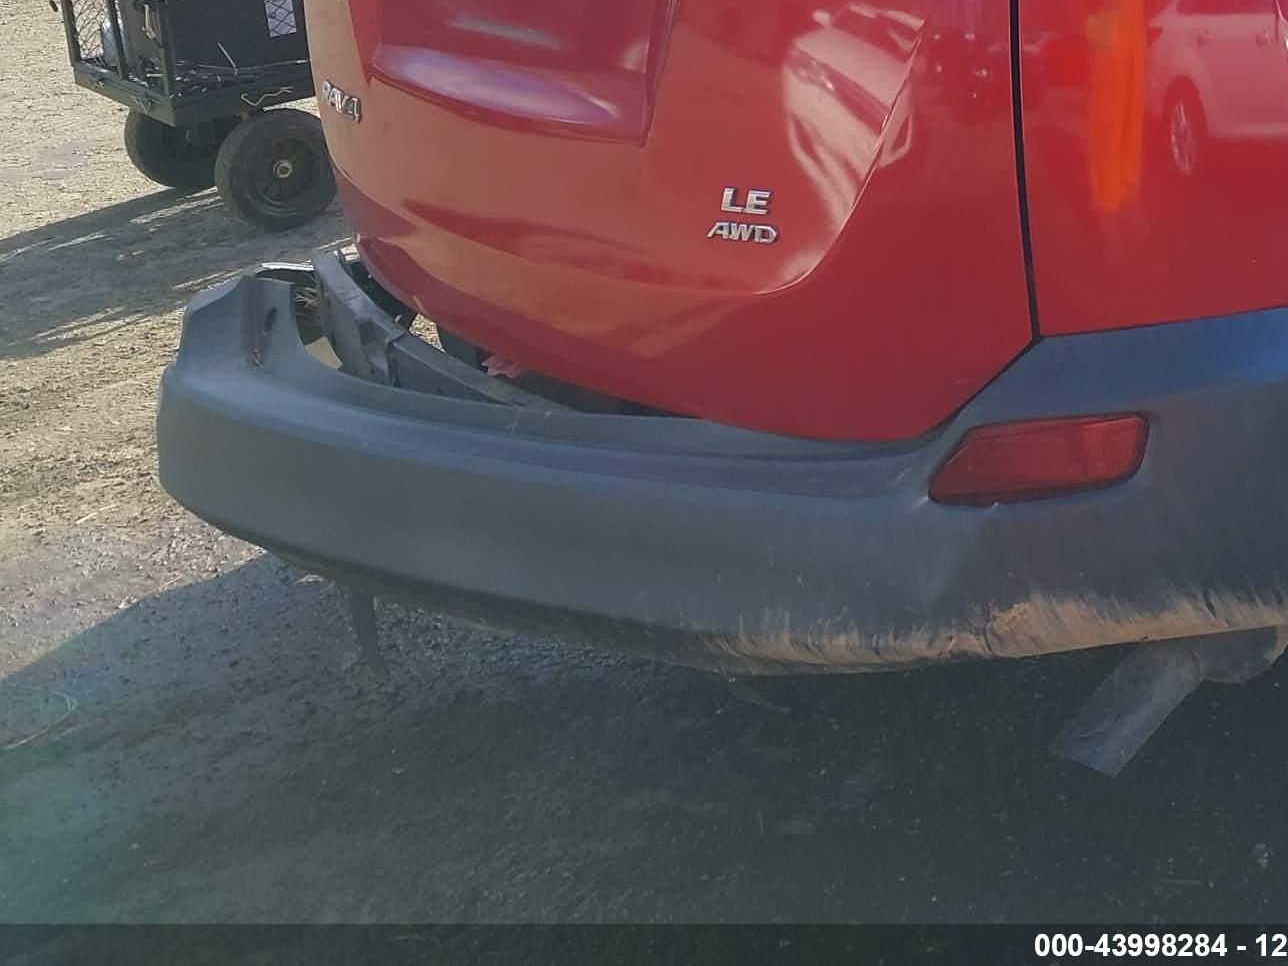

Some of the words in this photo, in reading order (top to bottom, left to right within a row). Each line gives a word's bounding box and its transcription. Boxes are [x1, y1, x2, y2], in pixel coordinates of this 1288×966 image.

[321, 79, 361, 124] RAV4
[720, 186, 772, 215] LE
[705, 221, 778, 244] AWD
